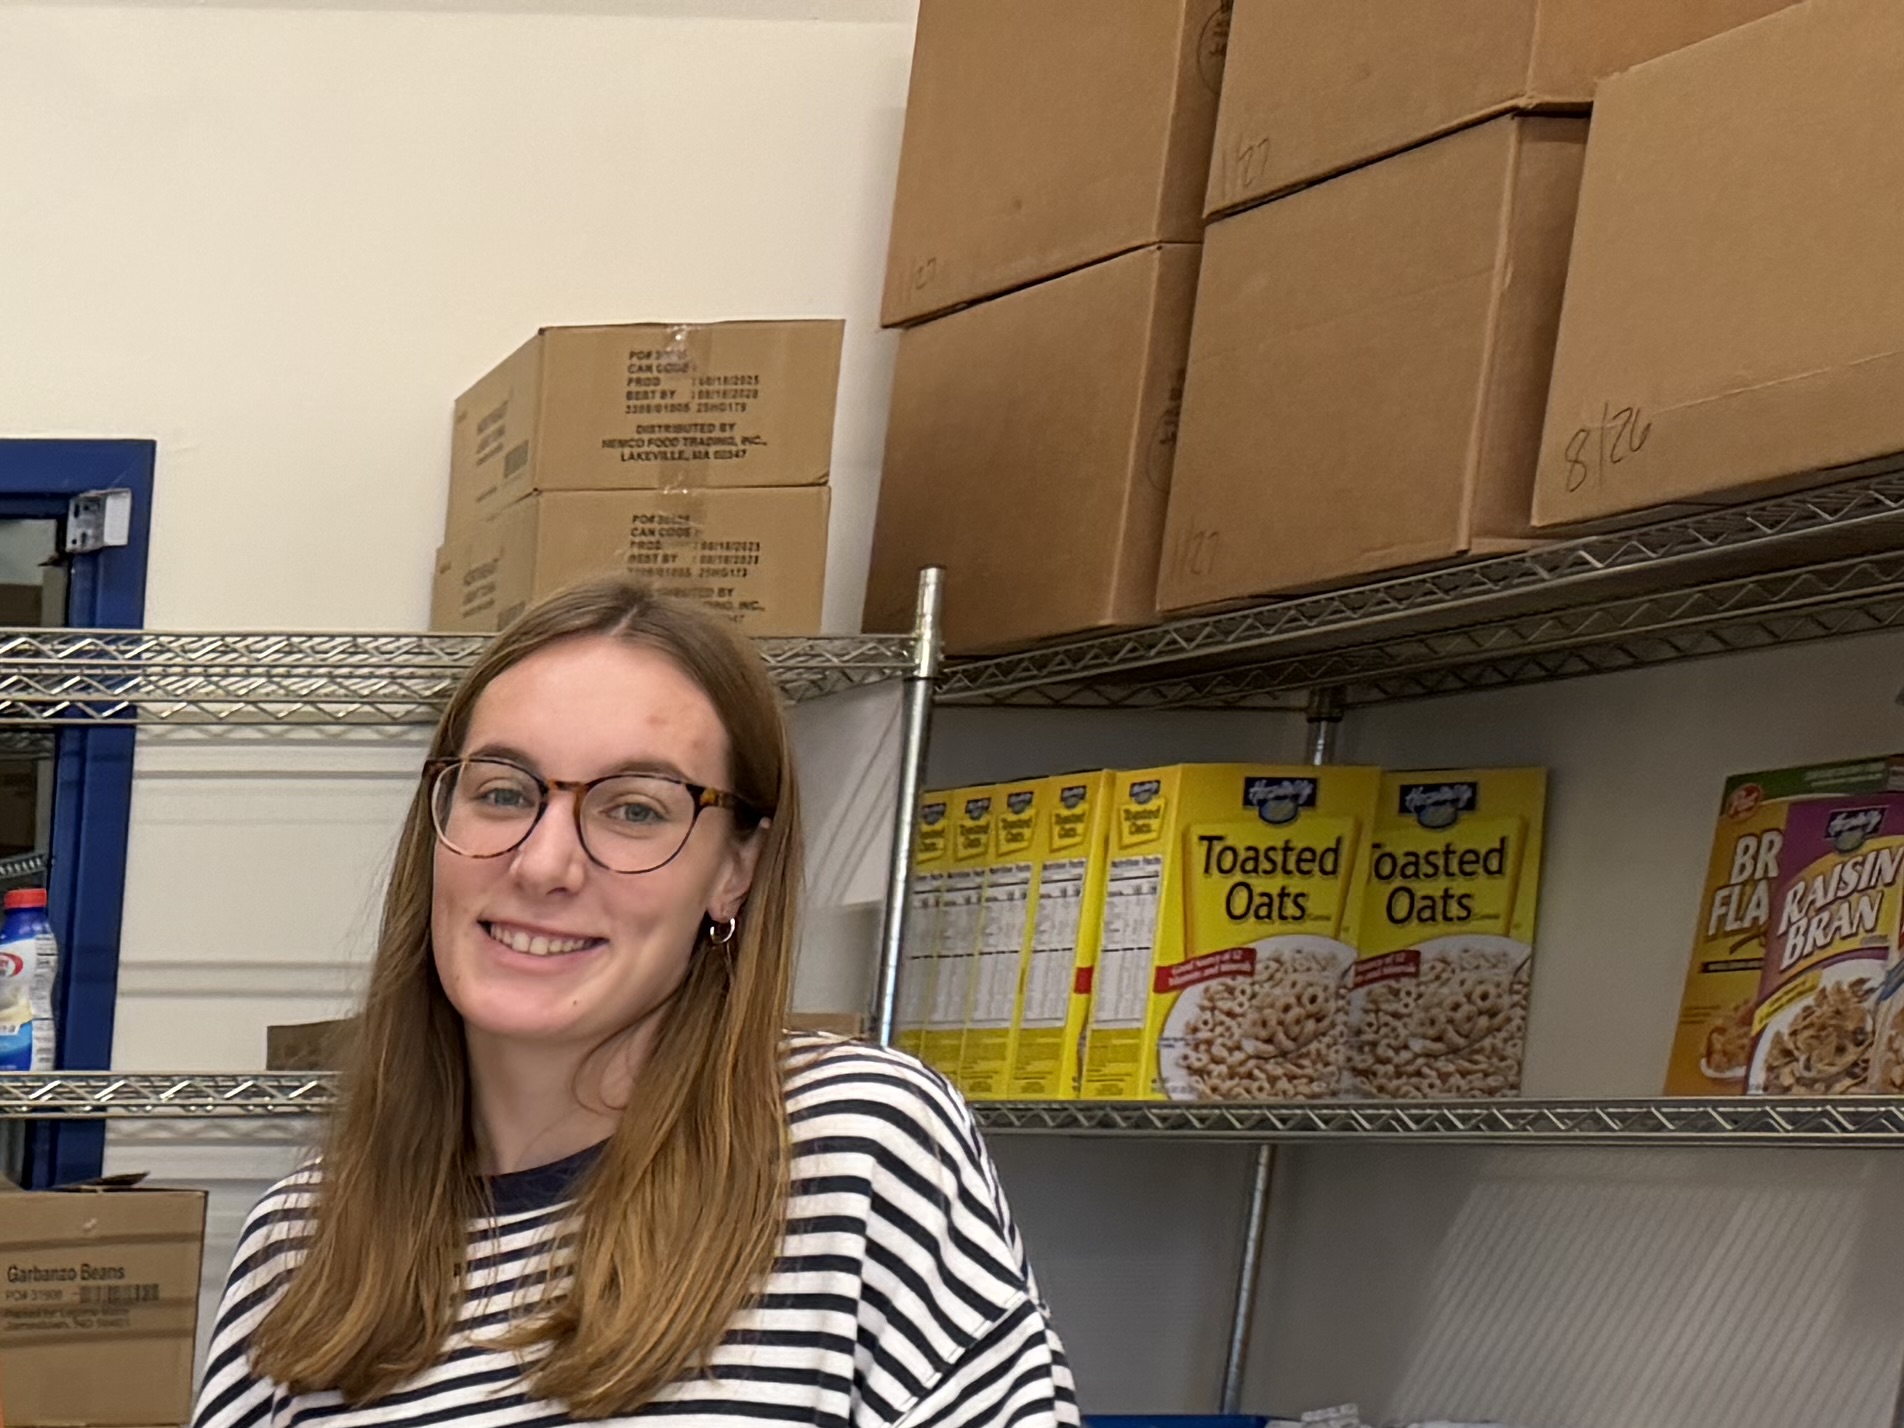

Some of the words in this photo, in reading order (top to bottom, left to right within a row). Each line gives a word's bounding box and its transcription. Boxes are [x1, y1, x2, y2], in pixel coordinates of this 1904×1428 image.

[636, 424, 716, 434] DISTRIBUTED
[719, 423, 736, 433] BY
[1198, 834, 1342, 877] Toasted
[1225, 881, 1310, 922] Oats
[1386, 886, 1474, 924] Oats
[1777, 847, 1903, 937] RAISIN
[1779, 889, 1884, 973] BRAN
[7, 1263, 78, 1283] Garbanzo
[79, 1263, 126, 1281] Beans
